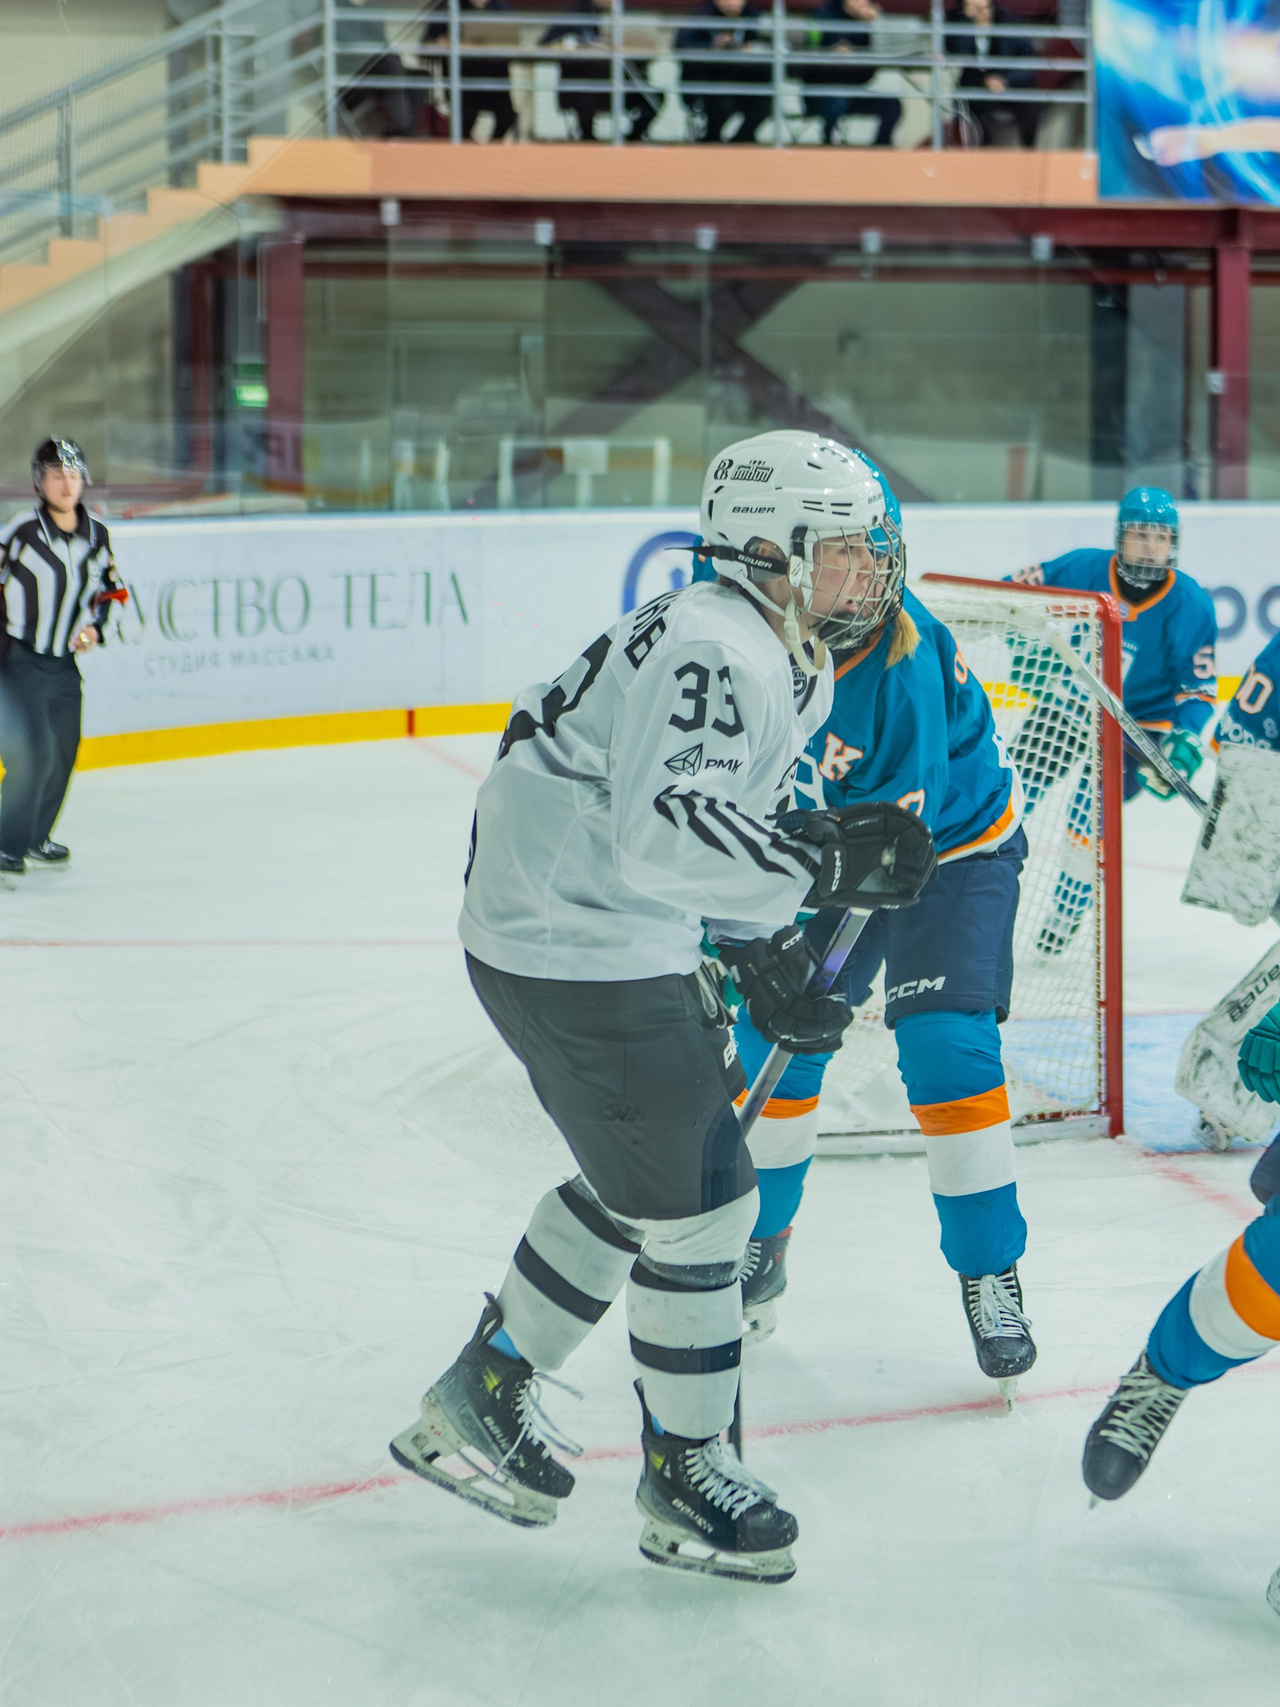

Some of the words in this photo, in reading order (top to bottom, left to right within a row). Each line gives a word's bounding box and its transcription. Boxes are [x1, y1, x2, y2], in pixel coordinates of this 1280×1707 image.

[731, 506, 776, 515] BAUER
[737, 554, 773, 570] BAUER
[331, 570, 470, 630] ТЕЛА
[668, 660, 746, 738] 33
[831, 850, 842, 892] CCM
[781, 930, 804, 951] CCM
[886, 975, 946, 1003] CCM
